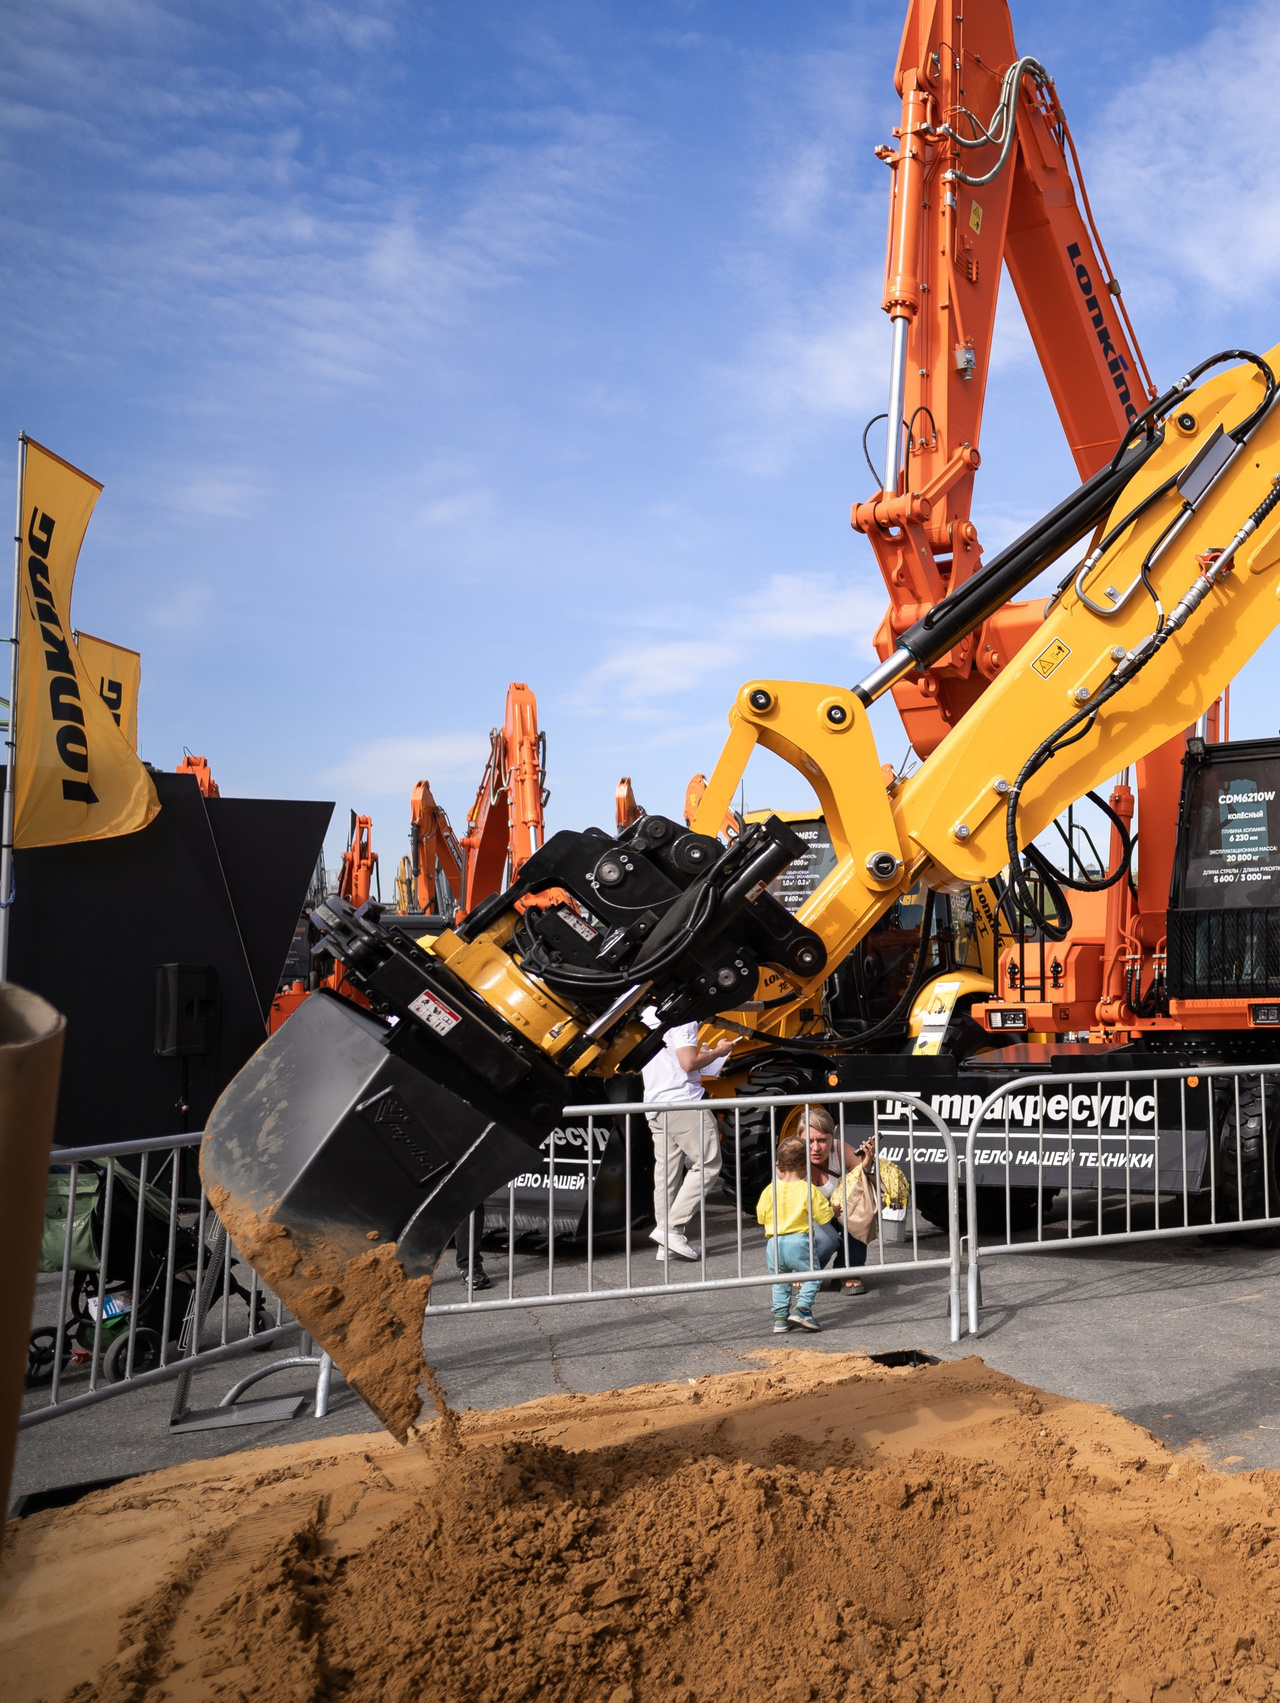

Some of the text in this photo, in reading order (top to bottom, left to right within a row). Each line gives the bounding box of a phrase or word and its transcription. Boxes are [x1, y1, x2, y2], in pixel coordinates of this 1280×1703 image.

[1218, 791, 1276, 805] CDM6210W
[1227, 810, 1264, 820] КОЛЁСНЫЙ
[1235, 834, 1249, 842] 230
[1213, 875, 1219, 883] 5
[1246, 873, 1262, 881] 000
[879, 1147, 901, 1161] АШ
